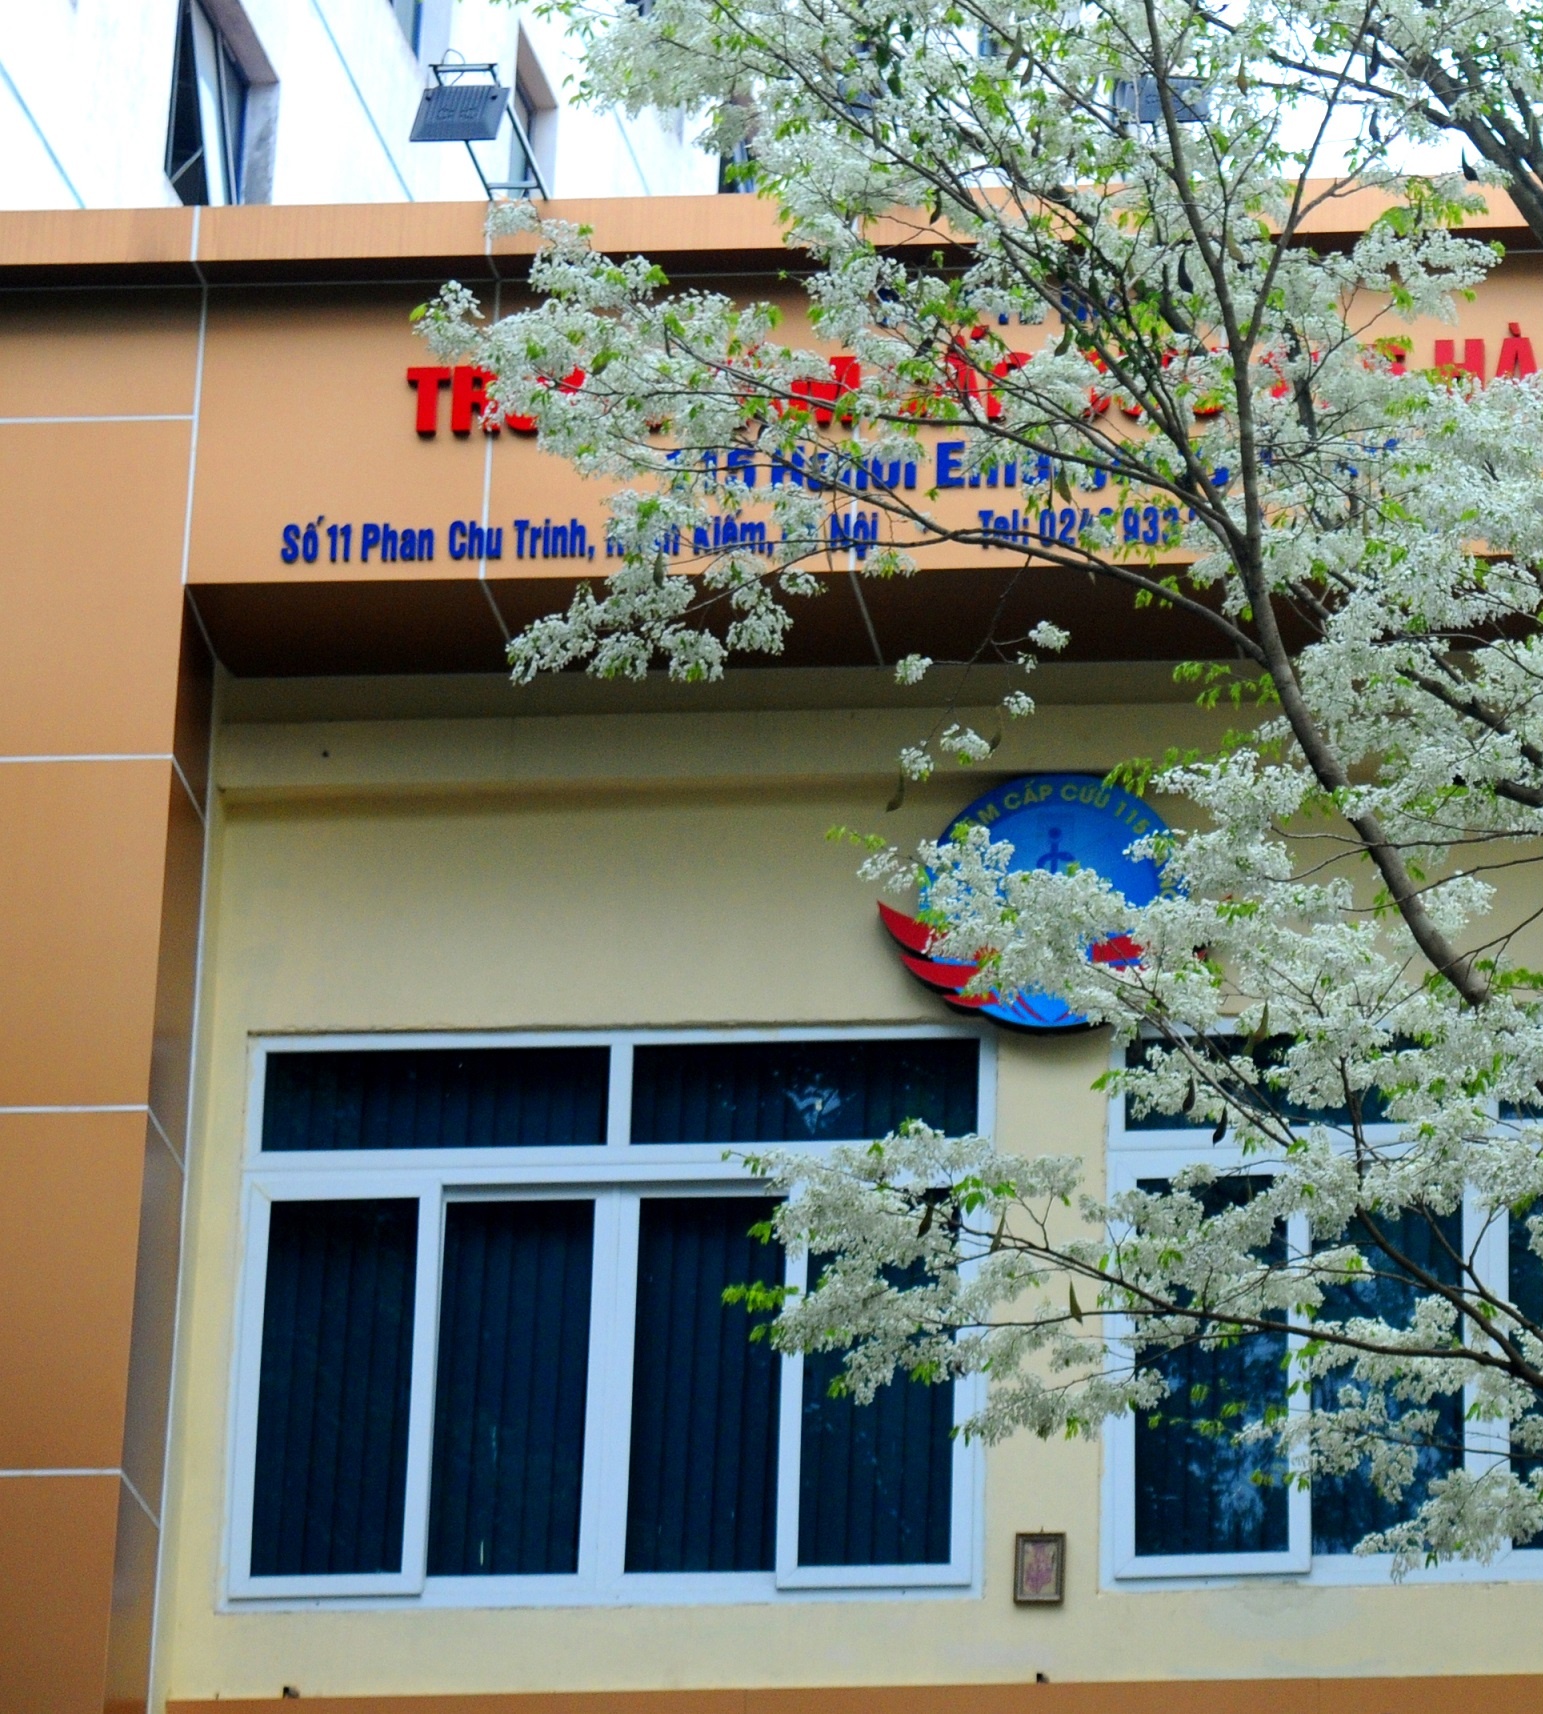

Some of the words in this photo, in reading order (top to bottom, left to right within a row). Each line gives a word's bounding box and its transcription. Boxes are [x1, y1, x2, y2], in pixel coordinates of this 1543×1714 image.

[281, 515, 325, 563] Số
[327, 523, 351, 562] 11
[361, 523, 434, 562] Phan
[449, 520, 503, 560] Chu
[514, 518, 596, 560] Trinh,
[978, 508, 1030, 550] Tel:
[1003, 780, 1054, 810] CẤP
[1114, 801, 1151, 834] 115
